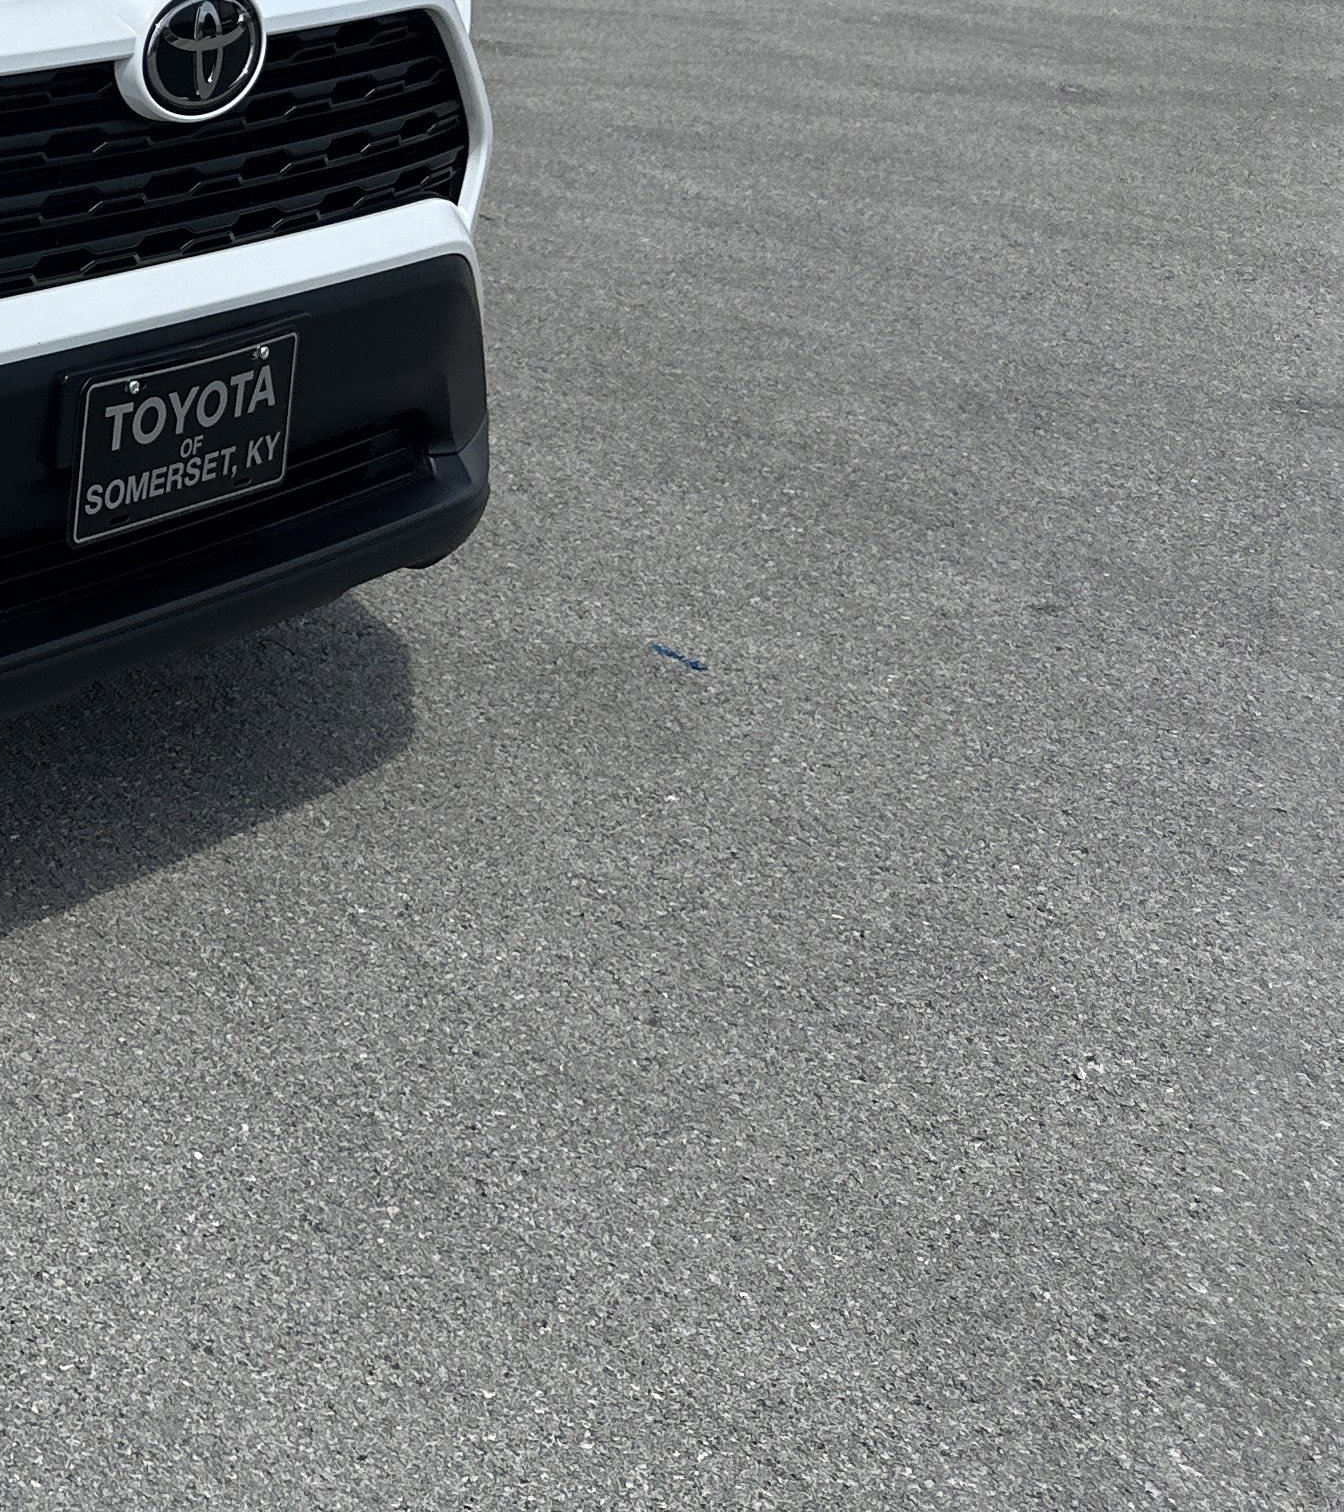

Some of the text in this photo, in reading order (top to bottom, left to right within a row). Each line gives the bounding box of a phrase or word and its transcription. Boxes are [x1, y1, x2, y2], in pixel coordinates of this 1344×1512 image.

[105, 364, 276, 451] TOYOTA
[180, 434, 204, 459] OF
[84, 431, 281, 516] SOMERSET, KY
